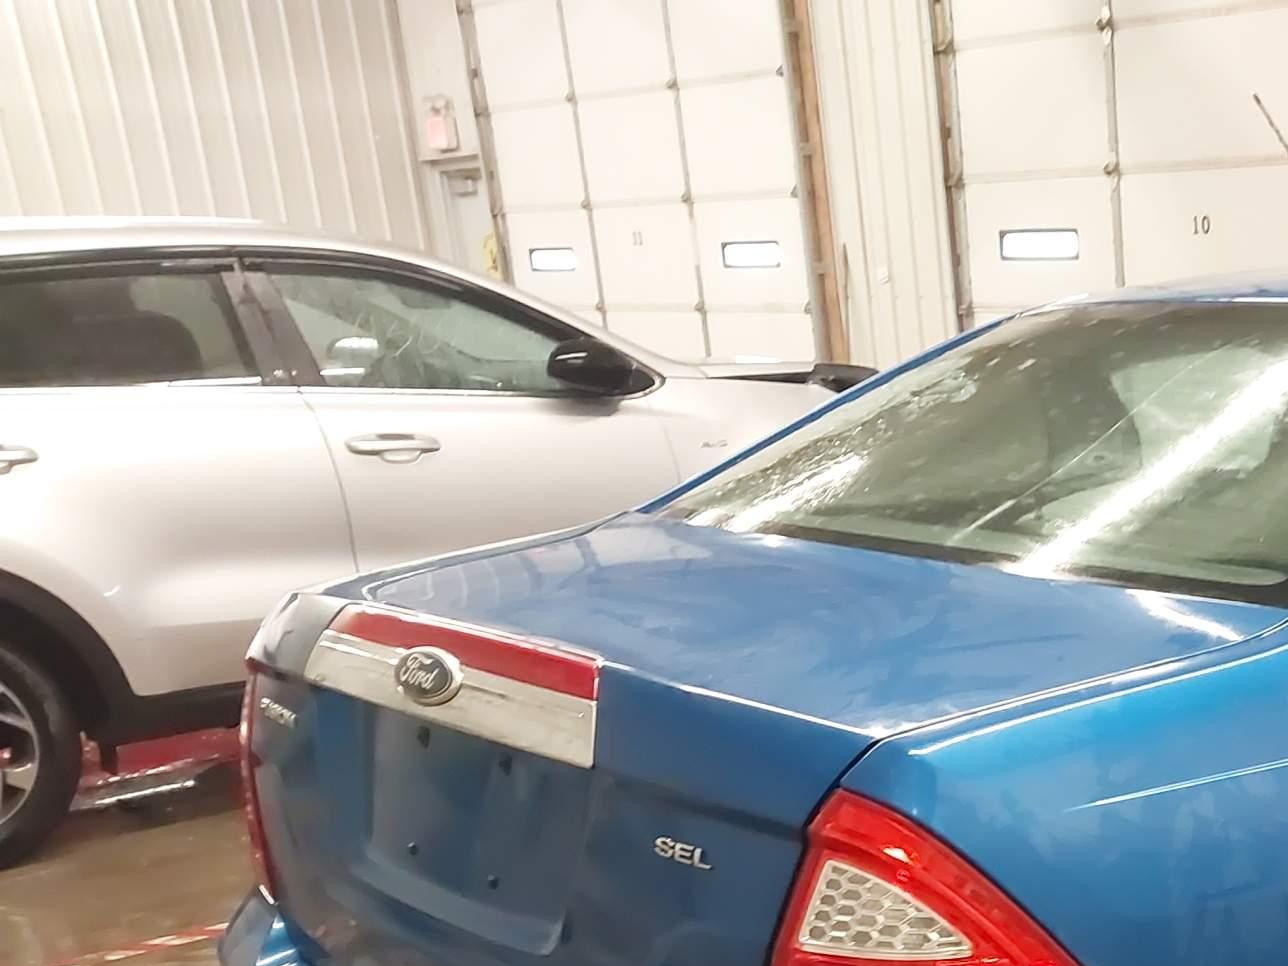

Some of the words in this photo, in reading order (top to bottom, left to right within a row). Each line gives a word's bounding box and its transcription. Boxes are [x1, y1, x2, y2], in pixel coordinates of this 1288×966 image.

[1193, 215, 1210, 234] 10
[400, 653, 440, 690] Ford
[655, 837, 712, 870] SEL
